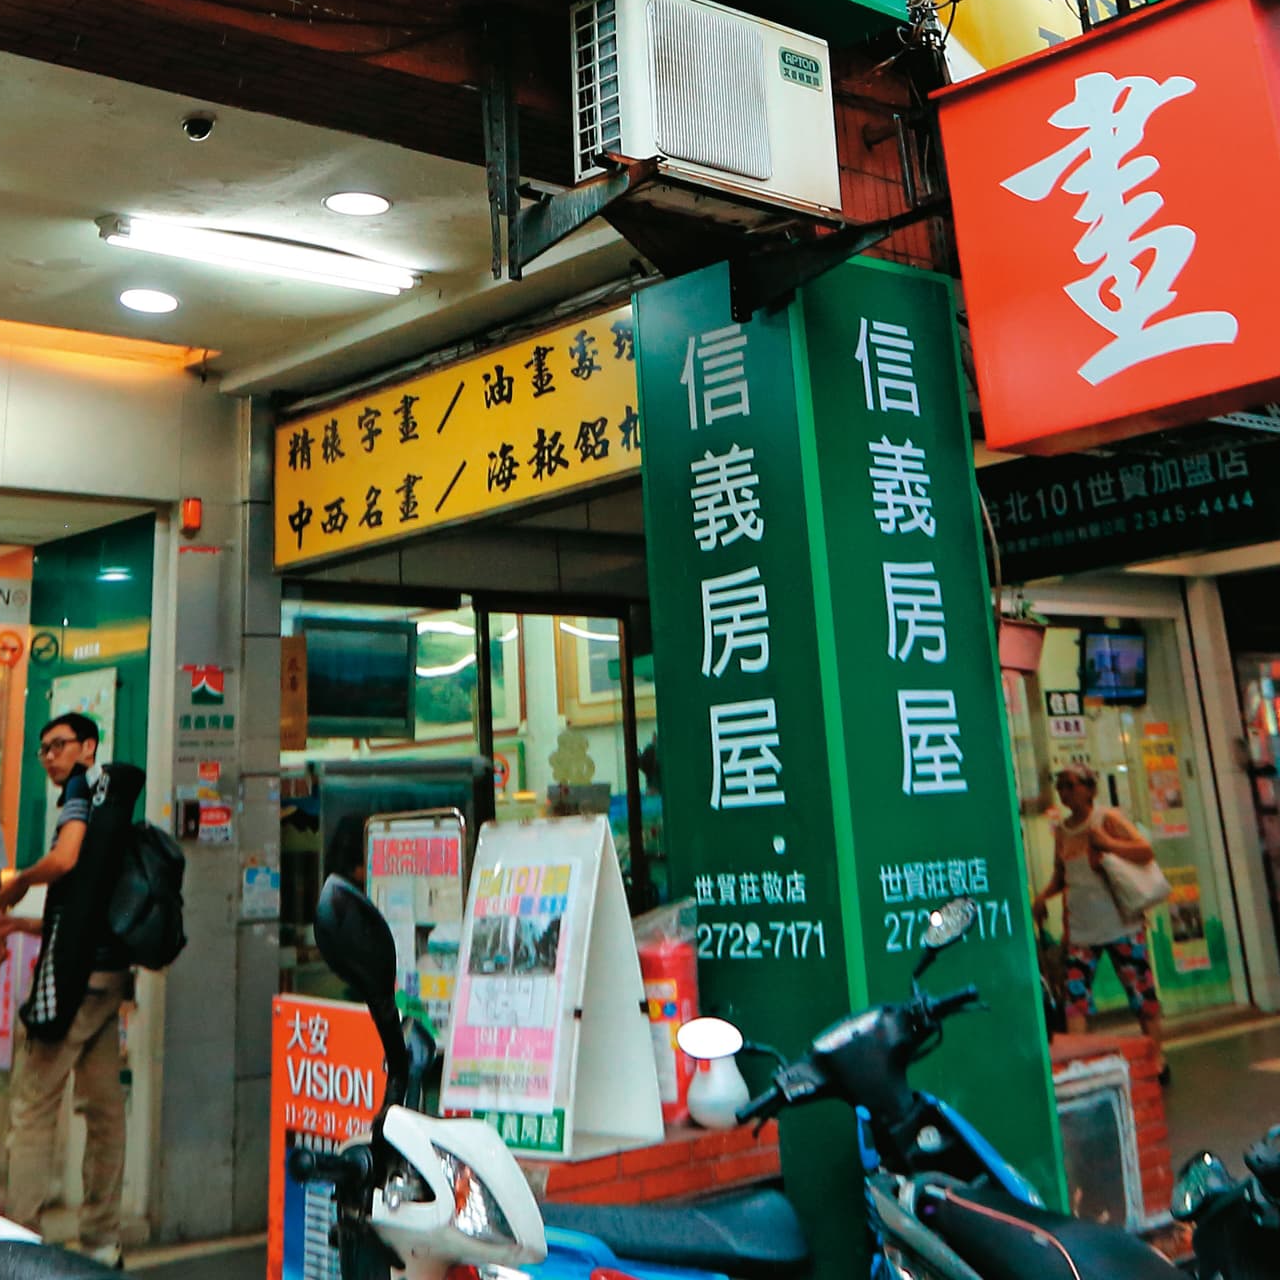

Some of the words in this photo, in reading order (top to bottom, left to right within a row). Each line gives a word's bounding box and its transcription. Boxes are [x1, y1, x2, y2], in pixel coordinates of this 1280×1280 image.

[999, 70, 1239, 387] 畫
[680, 322, 787, 812] 信義房屋
[854, 316, 968, 796] 信義房屋
[694, 870, 807, 906] 世貿莊敬店
[879, 857, 990, 903] 世貿莊敬店
[696, 919, 827, 960] 2722-7171
[286, 1009, 330, 1056] 大安
[286, 1055, 374, 1111] VISION
